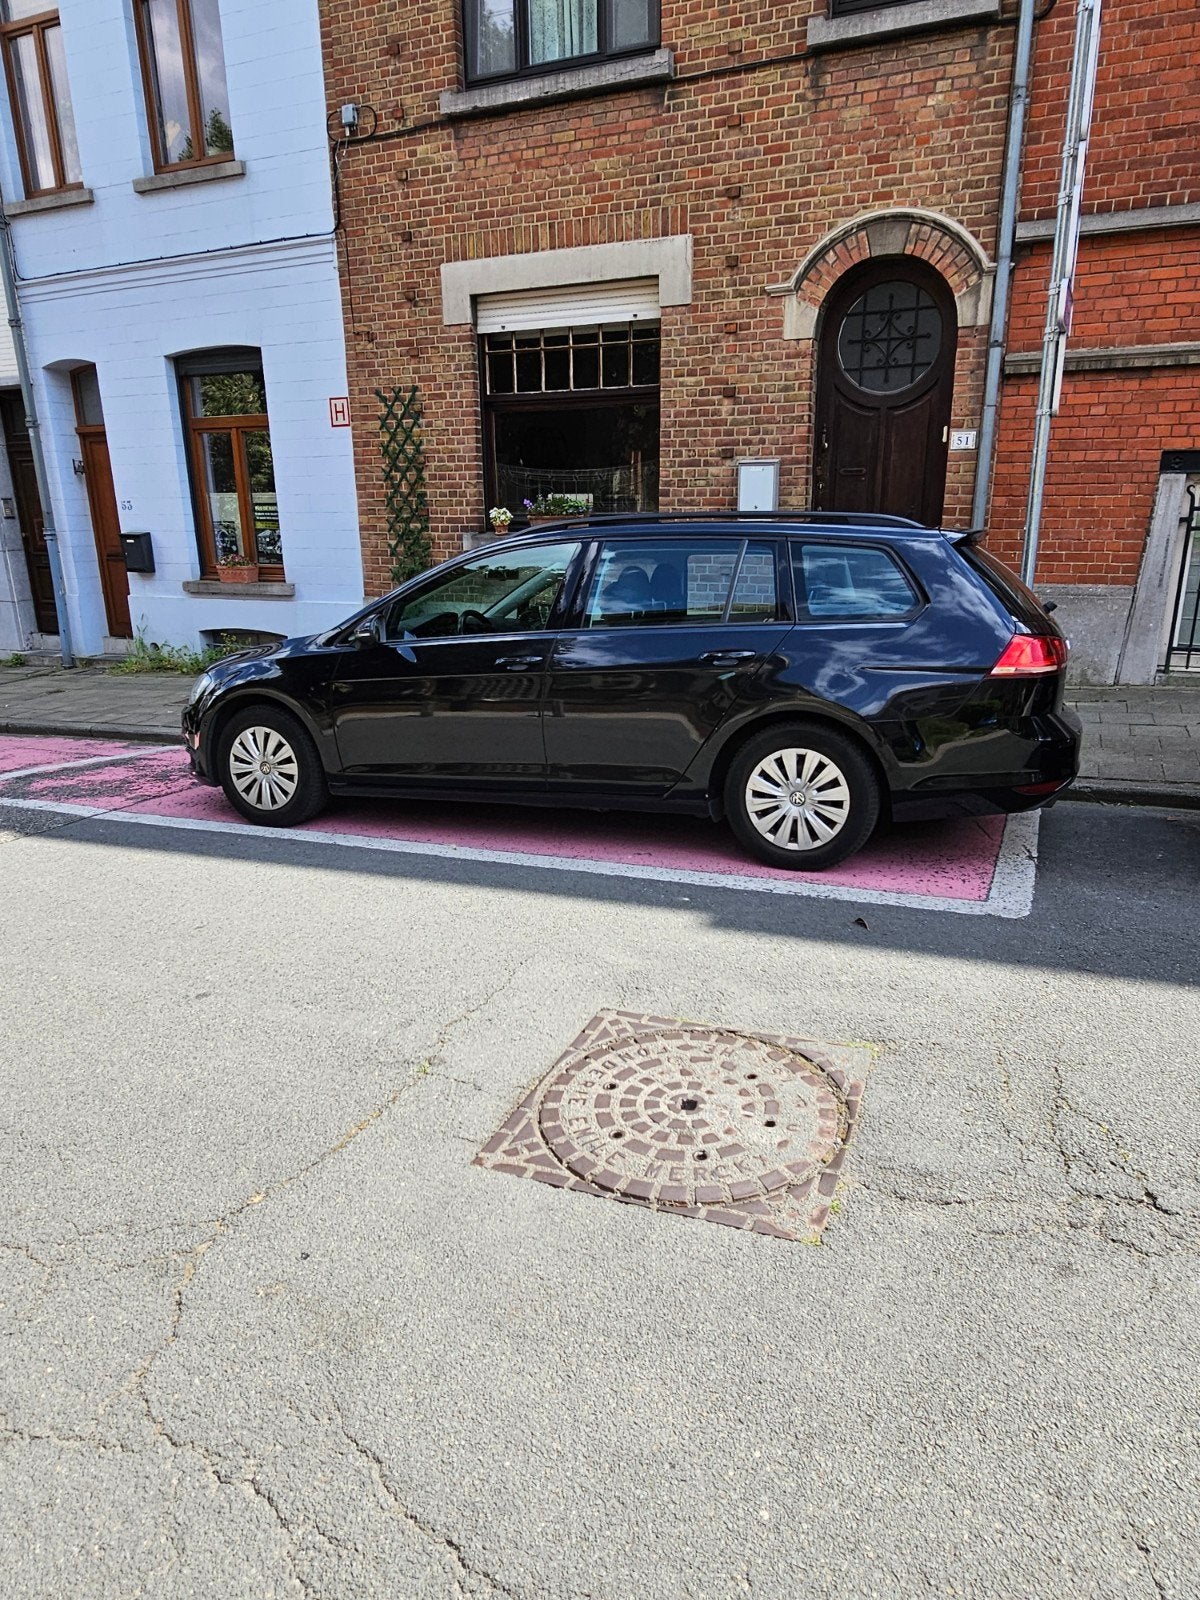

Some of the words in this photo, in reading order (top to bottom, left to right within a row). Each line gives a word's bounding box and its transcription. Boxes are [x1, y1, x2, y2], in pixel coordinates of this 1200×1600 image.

[334, 402, 346, 421] H
[956, 436, 970, 446] 51
[567, 1116, 628, 1167] EMILE
